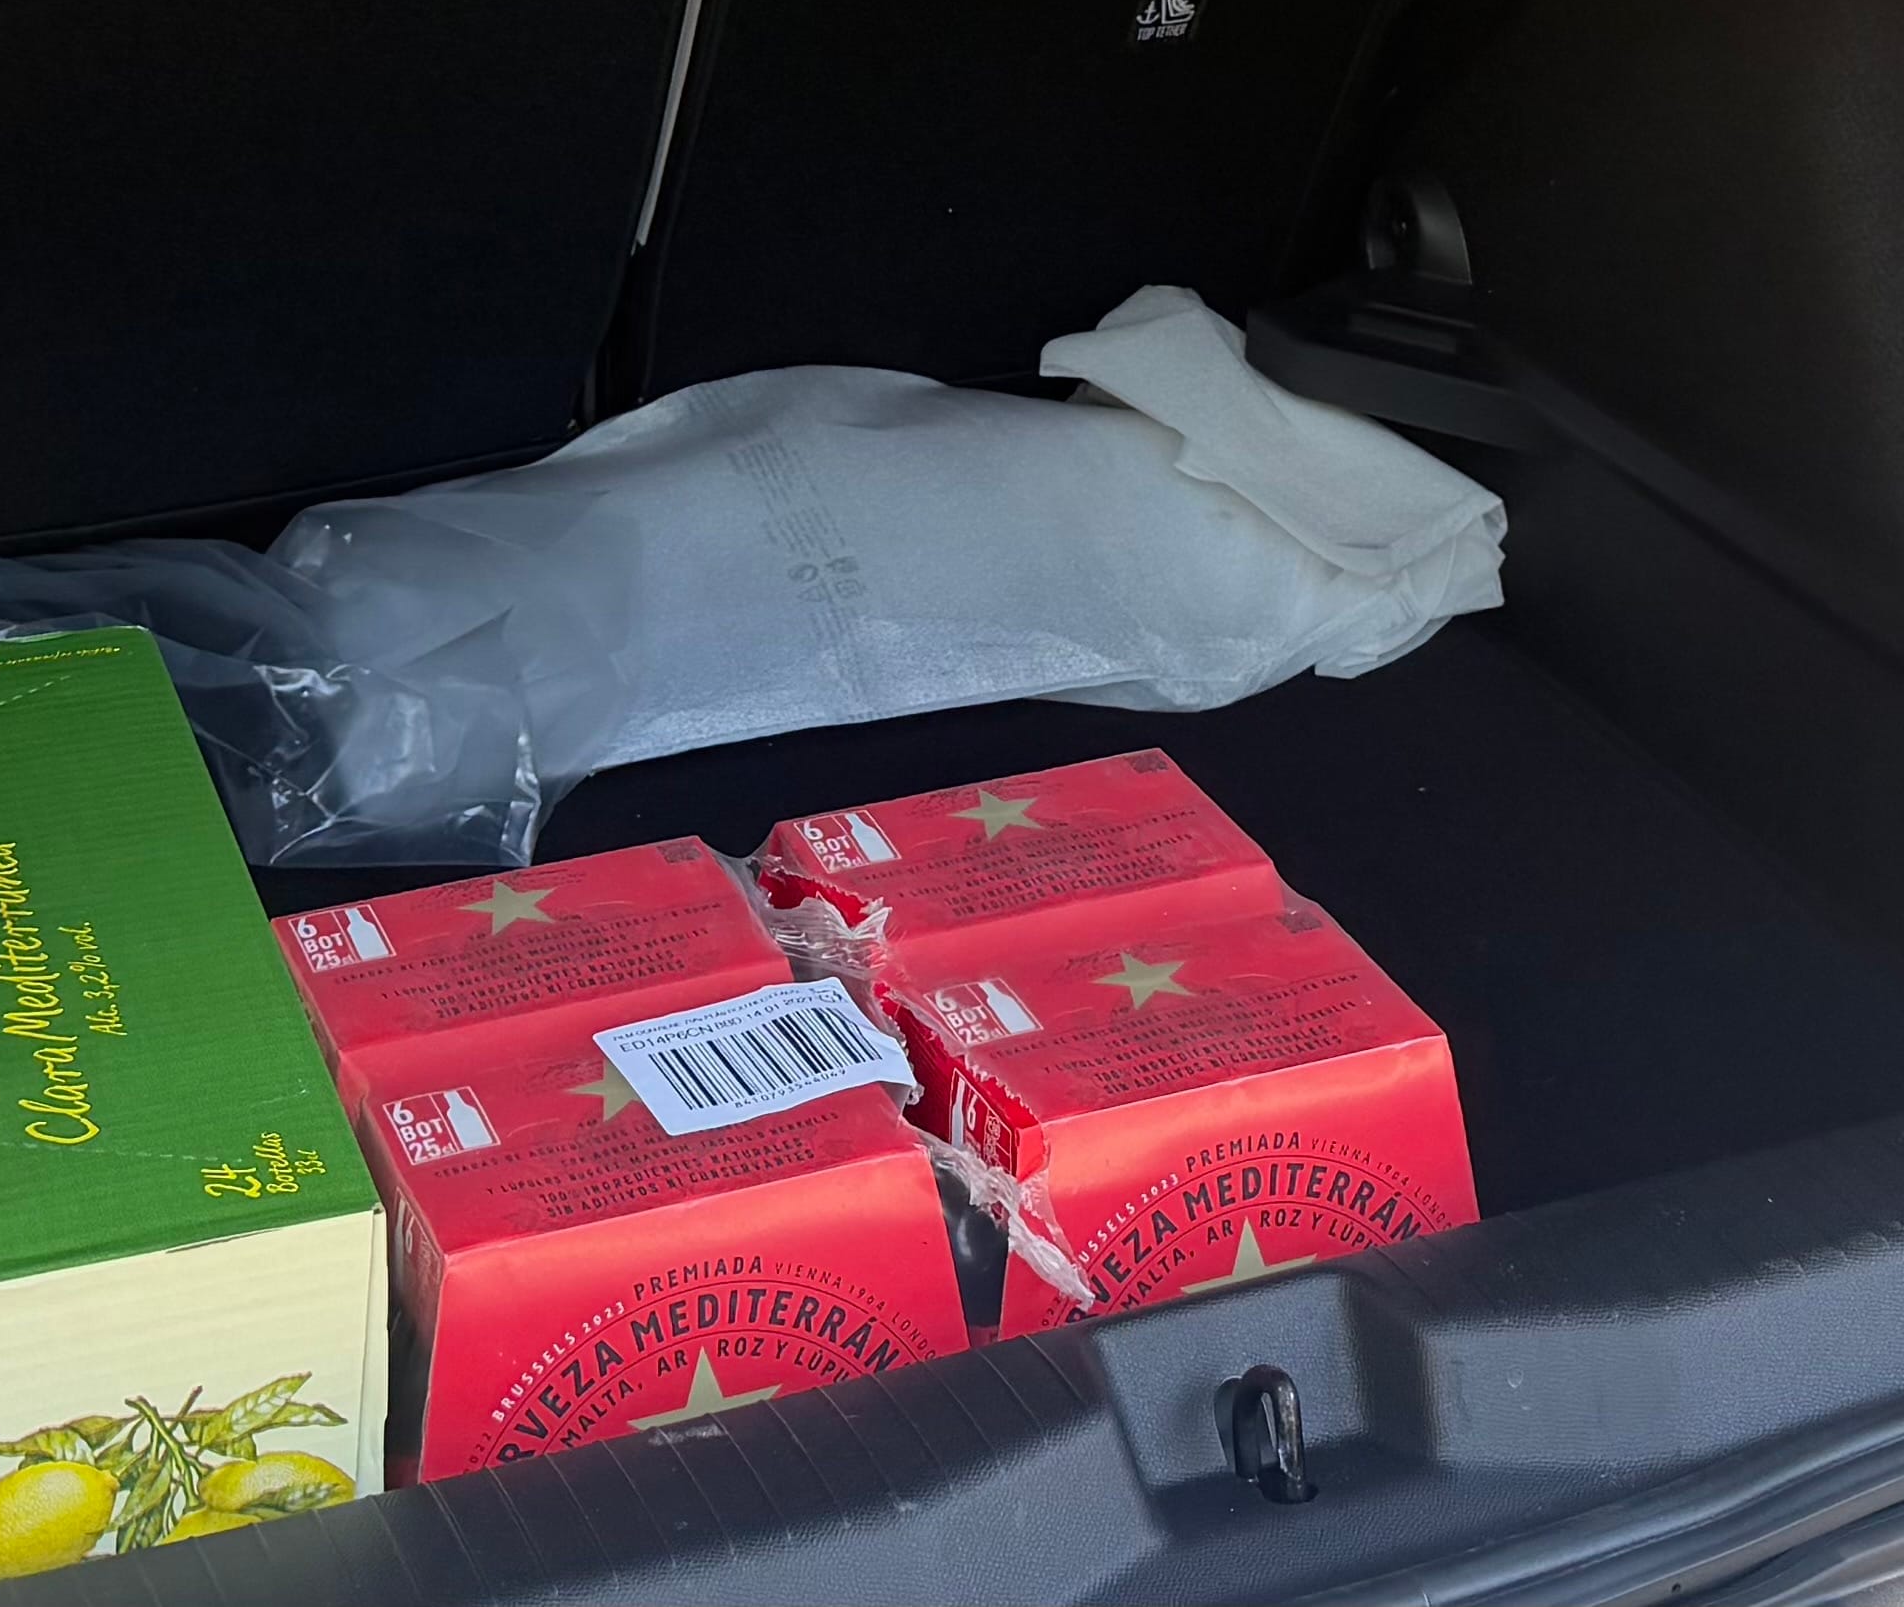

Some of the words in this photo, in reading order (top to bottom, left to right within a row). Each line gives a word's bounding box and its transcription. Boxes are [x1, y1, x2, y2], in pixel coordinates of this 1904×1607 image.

[802, 820, 823, 841] 6
[813, 834, 853, 856] BOT
[56, 922, 99, 951] vol.
[297, 918, 317, 939] 6
[304, 932, 345, 954] BOT
[67, 954, 121, 1000] 3,2%
[747, 1010, 762, 1020] 14
[765, 1003, 781, 1014] 01
[935, 990, 958, 1013] 6
[946, 1003, 988, 1028] BOT
[84, 1003, 128, 1037] Alc.
[18, 1045, 101, 1145] Clara
[393, 1101, 414, 1126] 6
[399, 1118, 444, 1143] BOT
[252, 1131, 300, 1194] Botellas
[408, 1137, 457, 1163] 25cl
[583, 1157, 703, 1195] INGREDIENTES
[710, 1136, 803, 1166] NATURALES
[1185, 1131, 1301, 1173] PREMIADA
[200, 1163, 263, 1198] 24
[546, 1201, 574, 1219] SIN
[580, 1180, 659, 1211] ADITIVOS
[664, 1174, 684, 1190] NI
[688, 1147, 814, 1186] CONSERVANTES
[1207, 1219, 1234, 1245] AR
[1260, 1208, 1302, 1228] ROZ
[1311, 1211, 1324, 1231] Y
[492, 1330, 577, 1423] BRUSSELS
[581, 1300, 626, 1335] 2023
[633, 1255, 763, 1301] PREMIADA
[774, 1261, 843, 1291] VIENNA
[630, 1288, 910, 1374] MEDITERRÁN
[559, 1379, 645, 1448] MALTA,
[657, 1349, 689, 1378] AR
[716, 1336, 766, 1358] ROZ
[775, 1339, 789, 1360] Y
